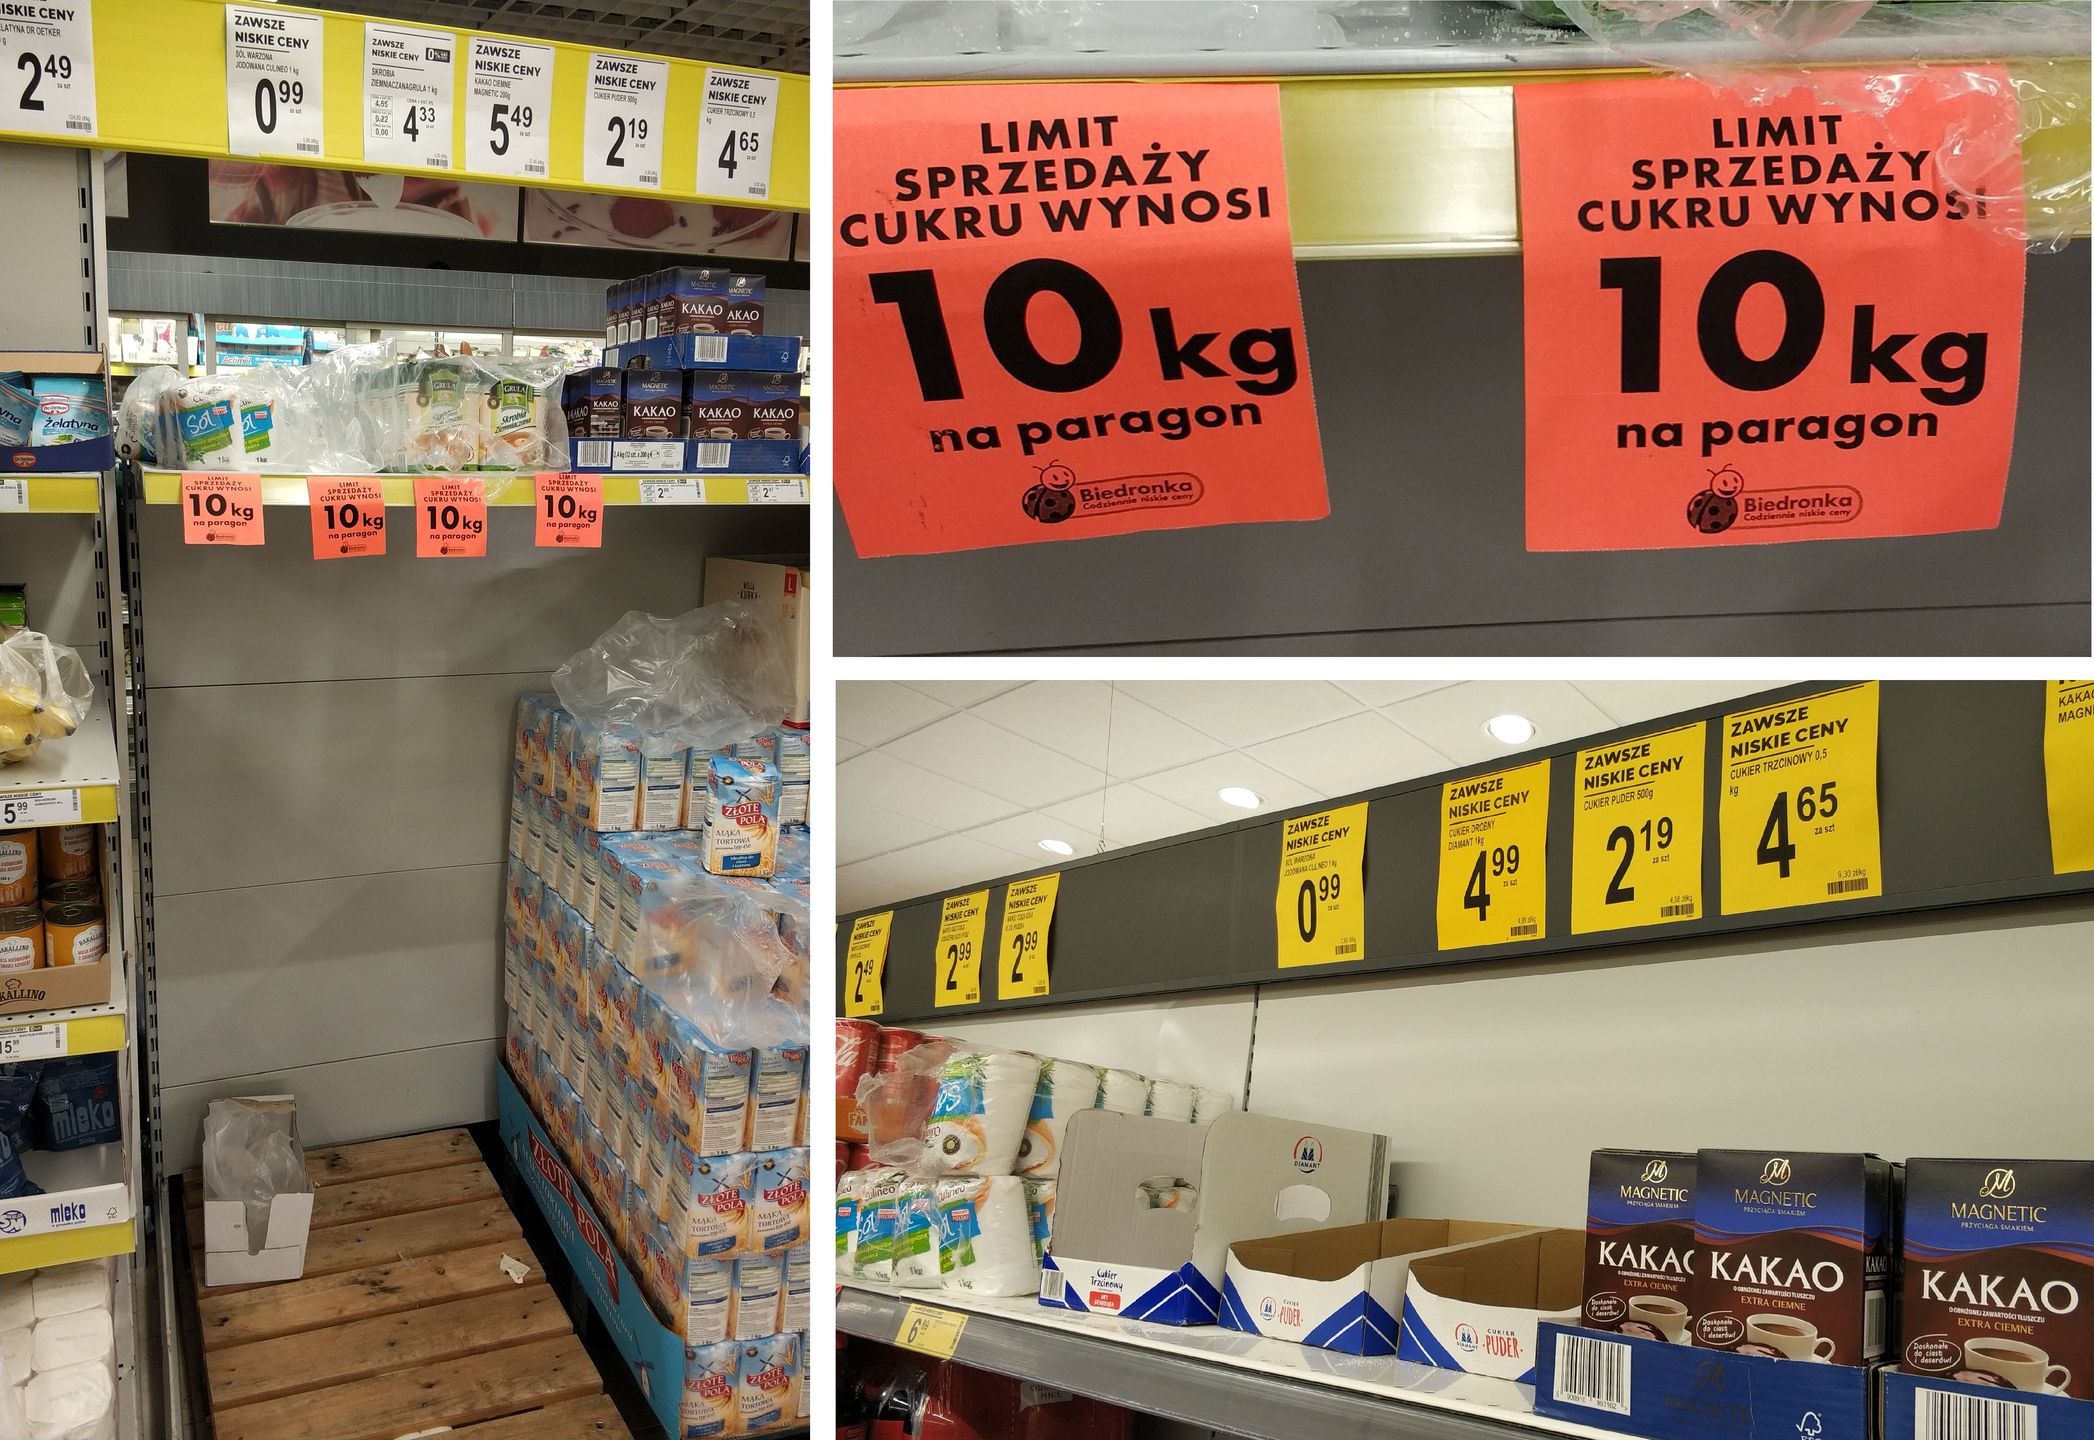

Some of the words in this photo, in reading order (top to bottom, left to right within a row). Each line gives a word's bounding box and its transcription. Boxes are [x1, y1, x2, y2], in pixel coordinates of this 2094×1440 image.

[39, 7, 75, 21] CENY
[234, 15, 285, 31] ZAWSZE
[36, 27, 61, 37] OETKER
[235, 31, 275, 46] NISKIE
[277, 36, 309, 50] CENY
[372, 38, 404, 49] ZAWSZE
[247, 51, 273, 61] WARZONA
[372, 49, 397, 59] NISKIE
[399, 52, 419, 61] CENY
[476, 44, 521, 60] ZAWSZE
[372, 67, 395, 77] SKROBIA
[475, 59, 510, 73] NISKIE
[512, 64, 541, 77] CENY
[595, 60, 638, 74] ZAWSZE
[474, 77, 492, 87] KAKAO
[493, 79, 511, 89] CIEMNE
[595, 74, 627, 88] NISKIE
[629, 79, 657, 91] CENY
[710, 76, 750, 89] ZAWSZE
[474, 87, 499, 98] MAGNETIC
[594, 91, 610, 100] CUKIER
[611, 93, 627, 102] PUDER
[708, 90, 740, 103] NISKIE
[741, 94, 767, 106] CENY
[981, 116, 1118, 154] LIMIT
[1712, 115, 1842, 148] LIMIT
[895, 142, 1210, 202] SPRZEDAŻY
[1632, 142, 1930, 190] SPRZEDAŻY
[840, 203, 1022, 247] CUKRU
[1040, 186, 1271, 233] WYNOSI
[1578, 196, 1750, 232] CUKRU
[1768, 187, 1987, 225] WYNOSI
[682, 303, 723, 316] KAKAO
[868, 257, 1123, 402] 10
[1150, 307, 1298, 397] kg
[1600, 250, 1825, 393] 10
[1850, 305, 1988, 406] kg
[504, 385, 526, 394] GRULA
[594, 400, 619, 408] KAKAO
[634, 406, 676, 417] KAKAO
[699, 408, 742, 419] KAKAO
[753, 408, 794, 419] KAKAO
[44, 417, 99, 431] Żelatyna
[186, 410, 216, 435] Sól
[929, 426, 1002, 454] na
[1017, 401, 1262, 456] paragon
[1617, 421, 1683, 449] na
[1701, 411, 1938, 458] paragon
[348, 493, 381, 501] WYNOSI
[1080, 480, 1193, 502] Biedronka
[189, 493, 227, 517] 10
[231, 503, 254, 521] kg
[544, 495, 576, 519] 10
[578, 505, 597, 523] kg
[1083, 497, 1138, 511] Codziennie
[1140, 494, 1170, 505] niskie
[1172, 493, 1195, 503] ceny
[1744, 494, 1852, 512] Biedronka
[324, 504, 360, 530] 10
[363, 513, 384, 530] kg
[427, 506, 460, 530] 10
[462, 516, 483, 534] kg
[1744, 509, 1796, 522] Codziennie
[1798, 509, 1826, 519] niskie
[1829, 508, 1852, 520] ceny
[207, 519, 248, 528] paragon
[558, 521, 591, 529] paragon
[328, 532, 340, 540] na
[341, 530, 378, 541] paragon
[442, 533, 477, 541] paragon
[1731, 706, 1809, 738] ZAWSZE
[1731, 732, 1790, 759] NISKIE
[1795, 718, 1849, 742] CENY
[1585, 743, 1651, 771] ZAWSZE
[1730, 765, 1761, 781] CUKIER
[1763, 753, 1813, 773] TRZCINOWY
[1815, 748, 1828, 761] 0,5
[1584, 766, 1635, 791] NISKIE
[1638, 756, 1684, 778] CENY
[1449, 777, 1504, 801] ZAWSZE
[1729, 785, 1739, 797] kg
[1449, 799, 1491, 820] NISKIE
[1493, 790, 1530, 809] CENY
[1583, 796, 1610, 811] CUKIER
[1611, 792, 1635, 806] PUDER
[1636, 788, 1654, 802] 500g
[725, 803, 760, 816] ZŁOTE
[740, 815, 766, 825] POLA
[1287, 815, 1330, 836] ZAWSZE
[1448, 824, 1470, 838] CUKIER
[1471, 819, 1496, 834] DROBNY
[1286, 834, 1319, 852] NISKIE
[1321, 826, 1350, 842] CENY
[1448, 837, 1473, 851] DIAMANT
[1010, 884, 1038, 897] ZAWSZE
[945, 898, 970, 911] ZAWSZE
[1008, 898, 1030, 910] NISKIE
[1030, 895, 1048, 905] CENY
[944, 910, 964, 922] NISKIE
[963, 907, 980, 918] CENY
[52, 1100, 115, 1141] mleko
[1294, 1161, 1321, 1170] DIAMANT
[701, 1189, 738, 1205] ZŁOTE
[767, 1182, 801, 1200] ZŁOTE
[781, 1191, 806, 1205] POLA
[1620, 1185, 1689, 1202] MAGNETIC
[1735, 1188, 1817, 1208] MAGNETIC
[51, 1202, 86, 1223] mleko
[717, 1200, 744, 1212] POLA
[1743, 1206, 1776, 1216] PRZYCIĄGA
[1777, 1209, 1806, 1217] SMAKIEM
[1951, 1202, 2047, 1224] MAGNETIC
[1961, 1222, 1999, 1231] PRZYCIĄGA
[2001, 1224, 2034, 1232] SMAKIEM
[1097, 1268, 1118, 1280] Cukier
[1710, 1251, 1844, 1292] KAKAO
[1090, 1276, 1124, 1292] Trzcinowy
[1623, 1279, 1648, 1288] EXTRA
[1650, 1281, 1678, 1292] CIEMNE
[1922, 1269, 2079, 1315] KAKAO
[1741, 1295, 1770, 1308] EXTRA
[1772, 1298, 1806, 1311] CIEMNE
[1279, 1306, 1301, 1327] PUDER
[1702, 1318, 1733, 1326] Doskonałe
[1982, 1310, 2017, 1320] ZAWARTOŚCI
[1487, 1328, 1515, 1337] CUKIER
[1957, 1318, 1991, 1330] EXTRA
[1994, 1321, 2034, 1335] CIEMNE
[1485, 1334, 1520, 1359] PUDER
[1913, 1340, 1948, 1351] Doskonałe
[689, 1376, 725, 1389] ZŁOTE
[750, 1368, 783, 1384] ZŁOTE
[764, 1377, 788, 1389] POLA
[705, 1386, 730, 1397] POLA
